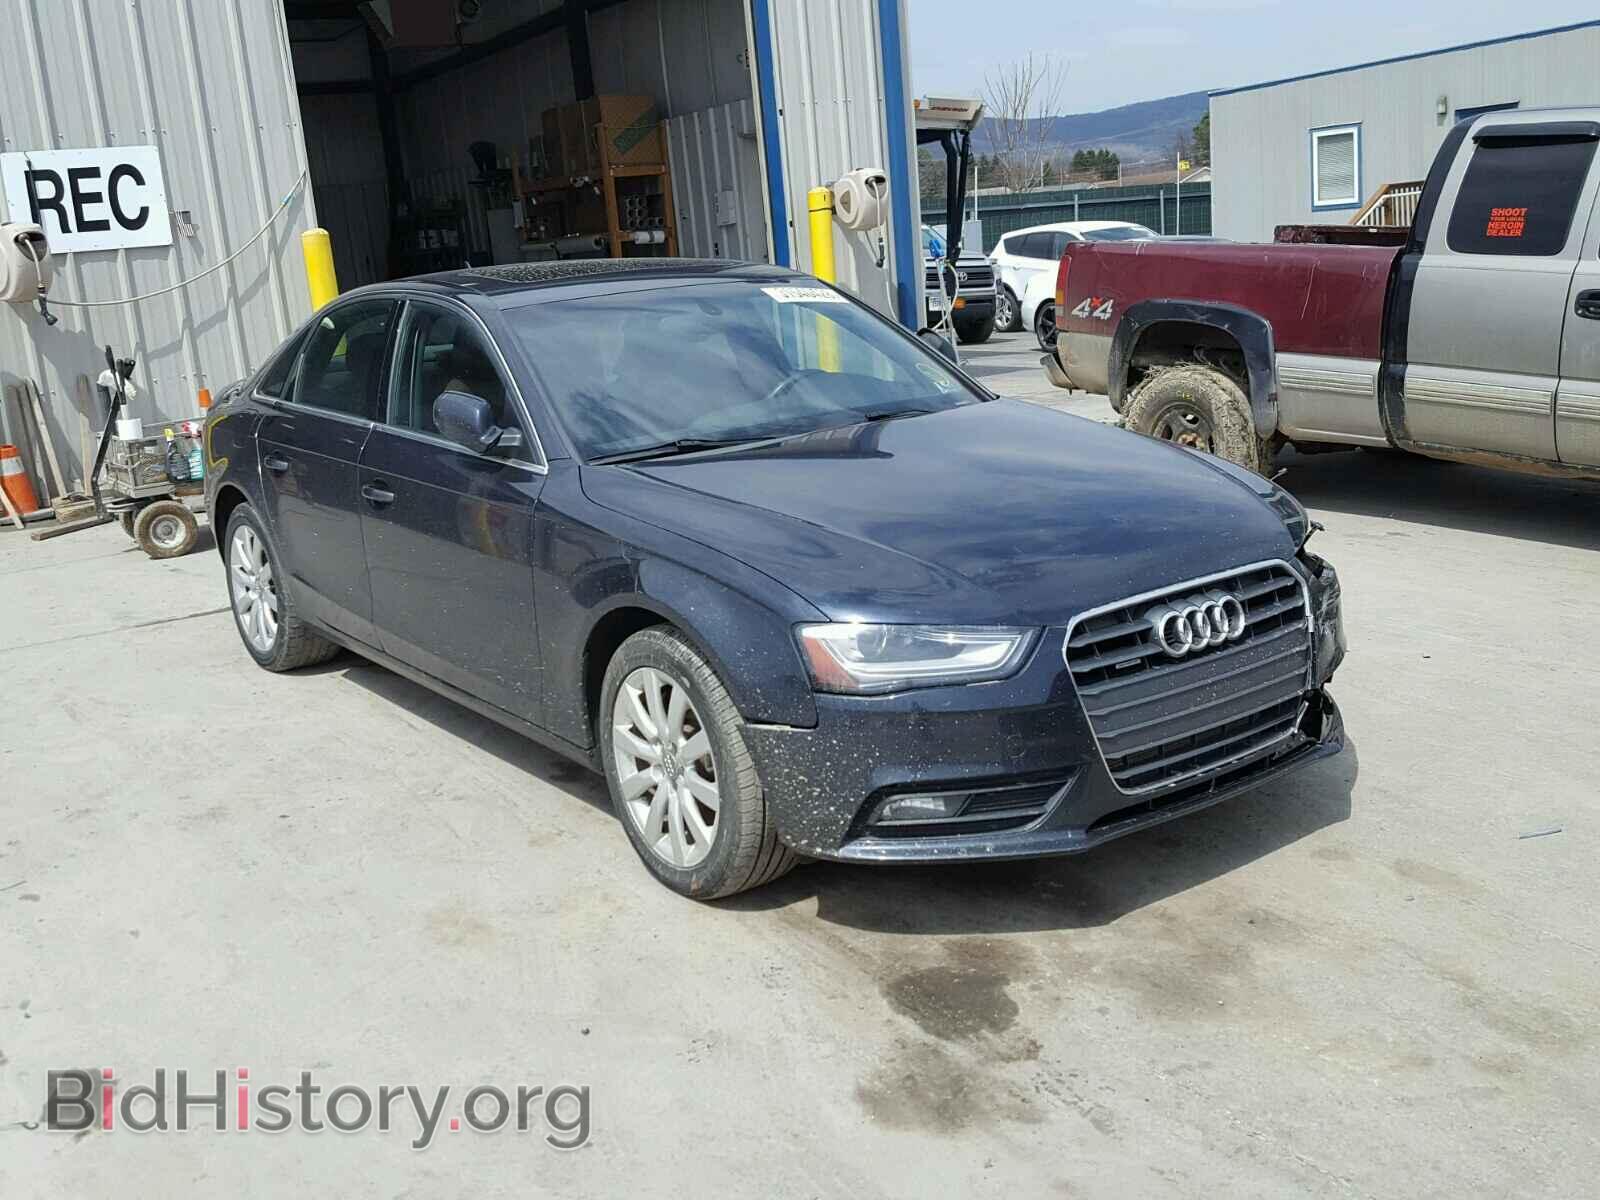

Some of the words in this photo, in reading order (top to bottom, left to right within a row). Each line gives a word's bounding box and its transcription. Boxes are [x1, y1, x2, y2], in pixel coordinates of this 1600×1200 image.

[24, 164, 150, 234] REC
[1491, 208, 1528, 216] SHOOT
[1488, 221, 1524, 229] HEROIN
